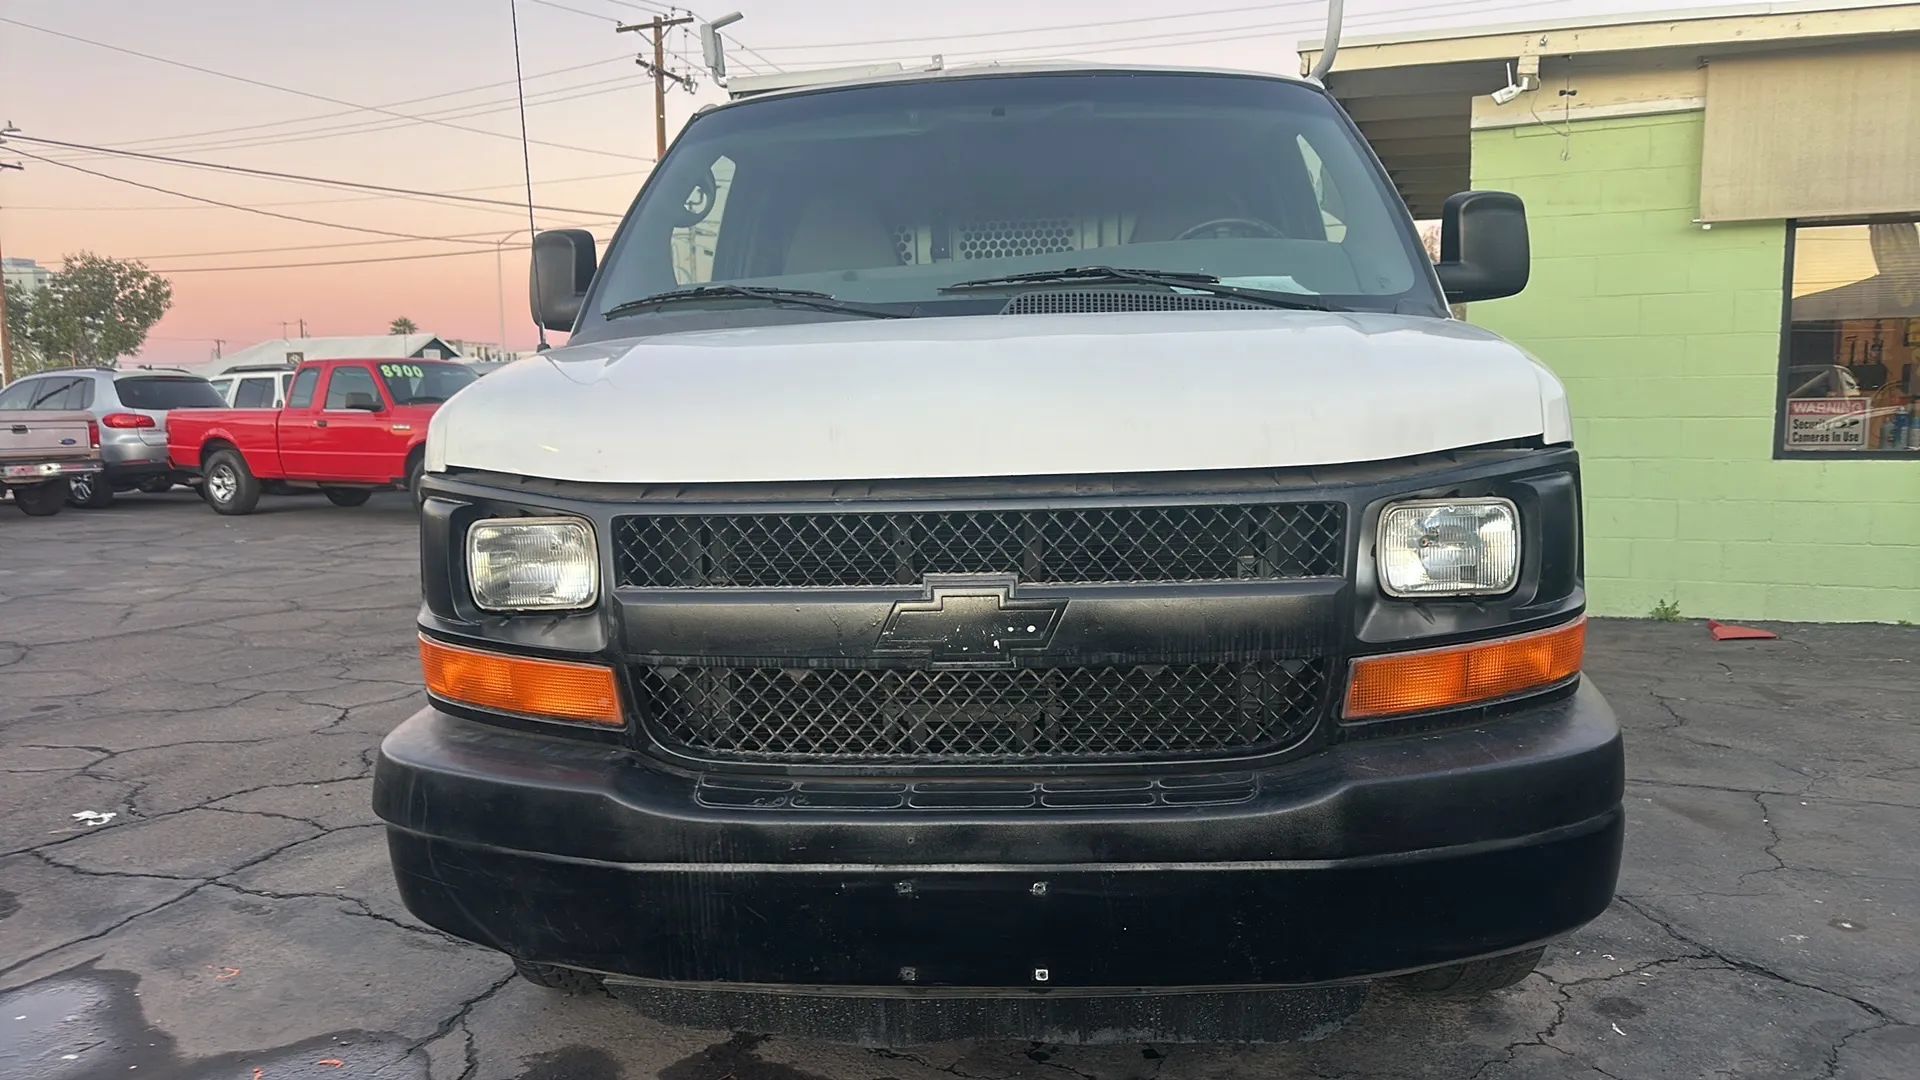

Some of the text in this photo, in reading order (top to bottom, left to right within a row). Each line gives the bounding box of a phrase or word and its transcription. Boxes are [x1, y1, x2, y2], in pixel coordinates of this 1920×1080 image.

[381, 364, 424, 378] 8900
[1792, 401, 1862, 413] WARNING
[1792, 432, 1830, 442] Cameras
[1843, 432, 1859, 442] Use
